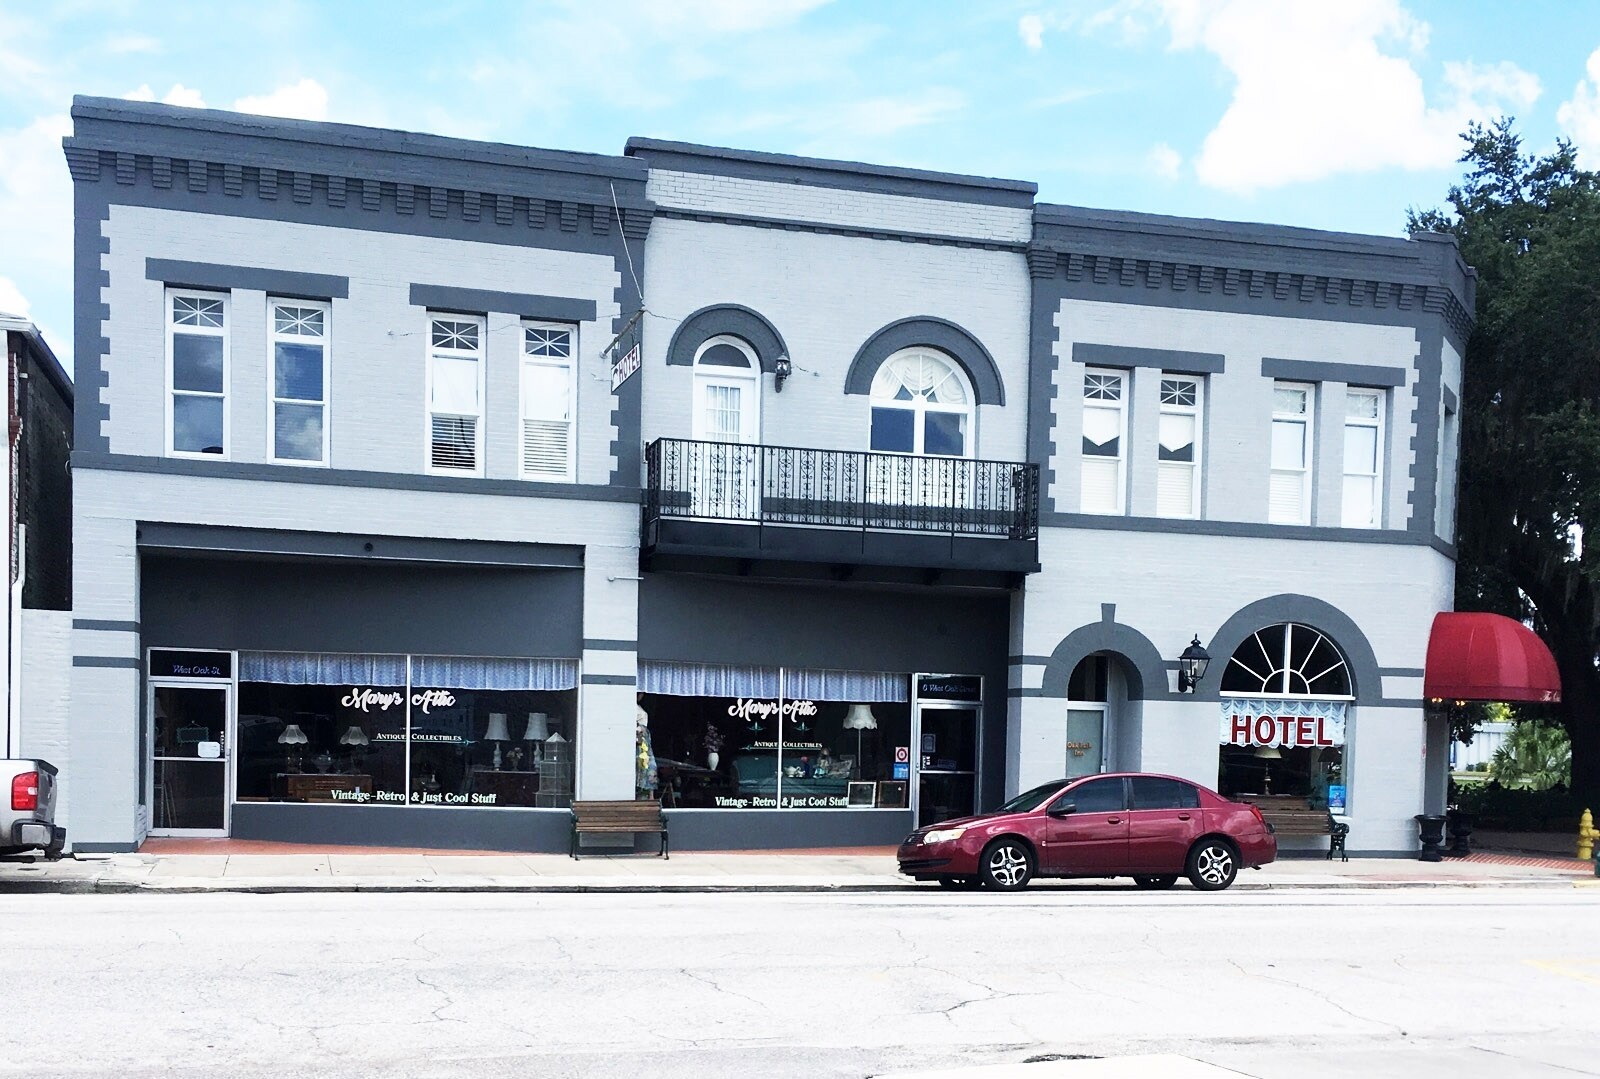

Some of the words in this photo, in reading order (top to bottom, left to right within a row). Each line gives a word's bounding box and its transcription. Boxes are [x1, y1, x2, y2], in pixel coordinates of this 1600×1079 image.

[618, 346, 640, 383] HOTEL
[192, 666, 210, 675] Oak
[341, 687, 404, 713] Mary's
[411, 689, 456, 715] Attic
[727, 697, 780, 722] Mary's
[782, 699, 818, 723] Attic
[411, 733, 463, 741] COLLECTIBLES
[1229, 714, 1334, 747] HOTEL
[411, 791, 419, 801] &
[420, 791, 442, 804] Just
[445, 792, 468, 803] Cool
[471, 793, 496, 804] Stuff
[781, 796, 788, 806] &
[789, 796, 806, 808] Just
[808, 796, 827, 806] Cool
[829, 797, 849, 806] Stuff
